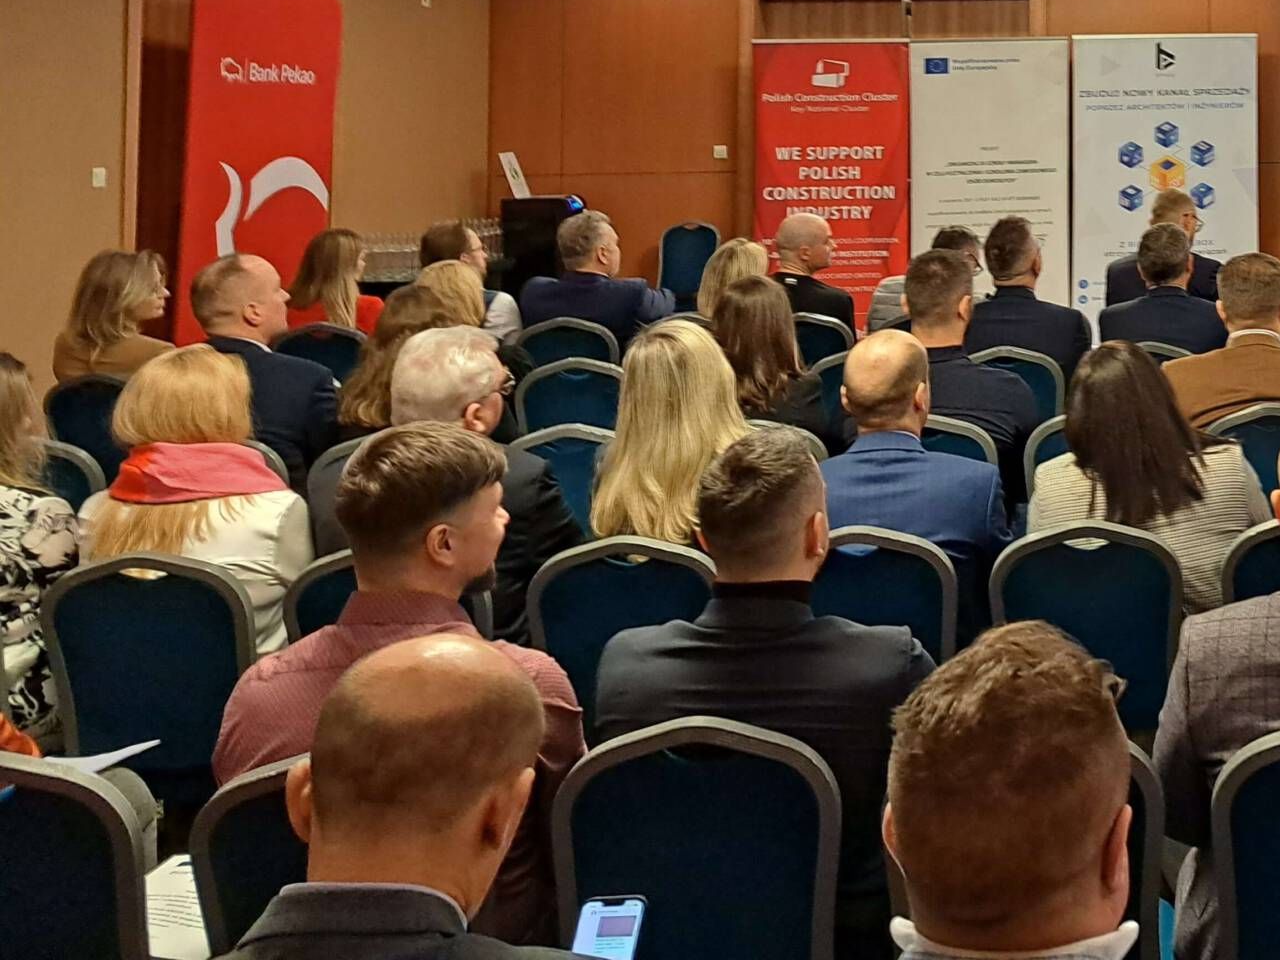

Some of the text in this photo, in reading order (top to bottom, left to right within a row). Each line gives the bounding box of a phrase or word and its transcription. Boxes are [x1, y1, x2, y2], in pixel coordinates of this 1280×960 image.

[249, 62, 316, 85] Bank Pekao
[762, 92, 898, 102] Polish Construction Cluster
[1123, 89, 1153, 97] NOWY
[775, 146, 885, 160] WE SUPPORT
[798, 166, 861, 180] POLISH
[763, 186, 896, 200] CONSTRUCTION
